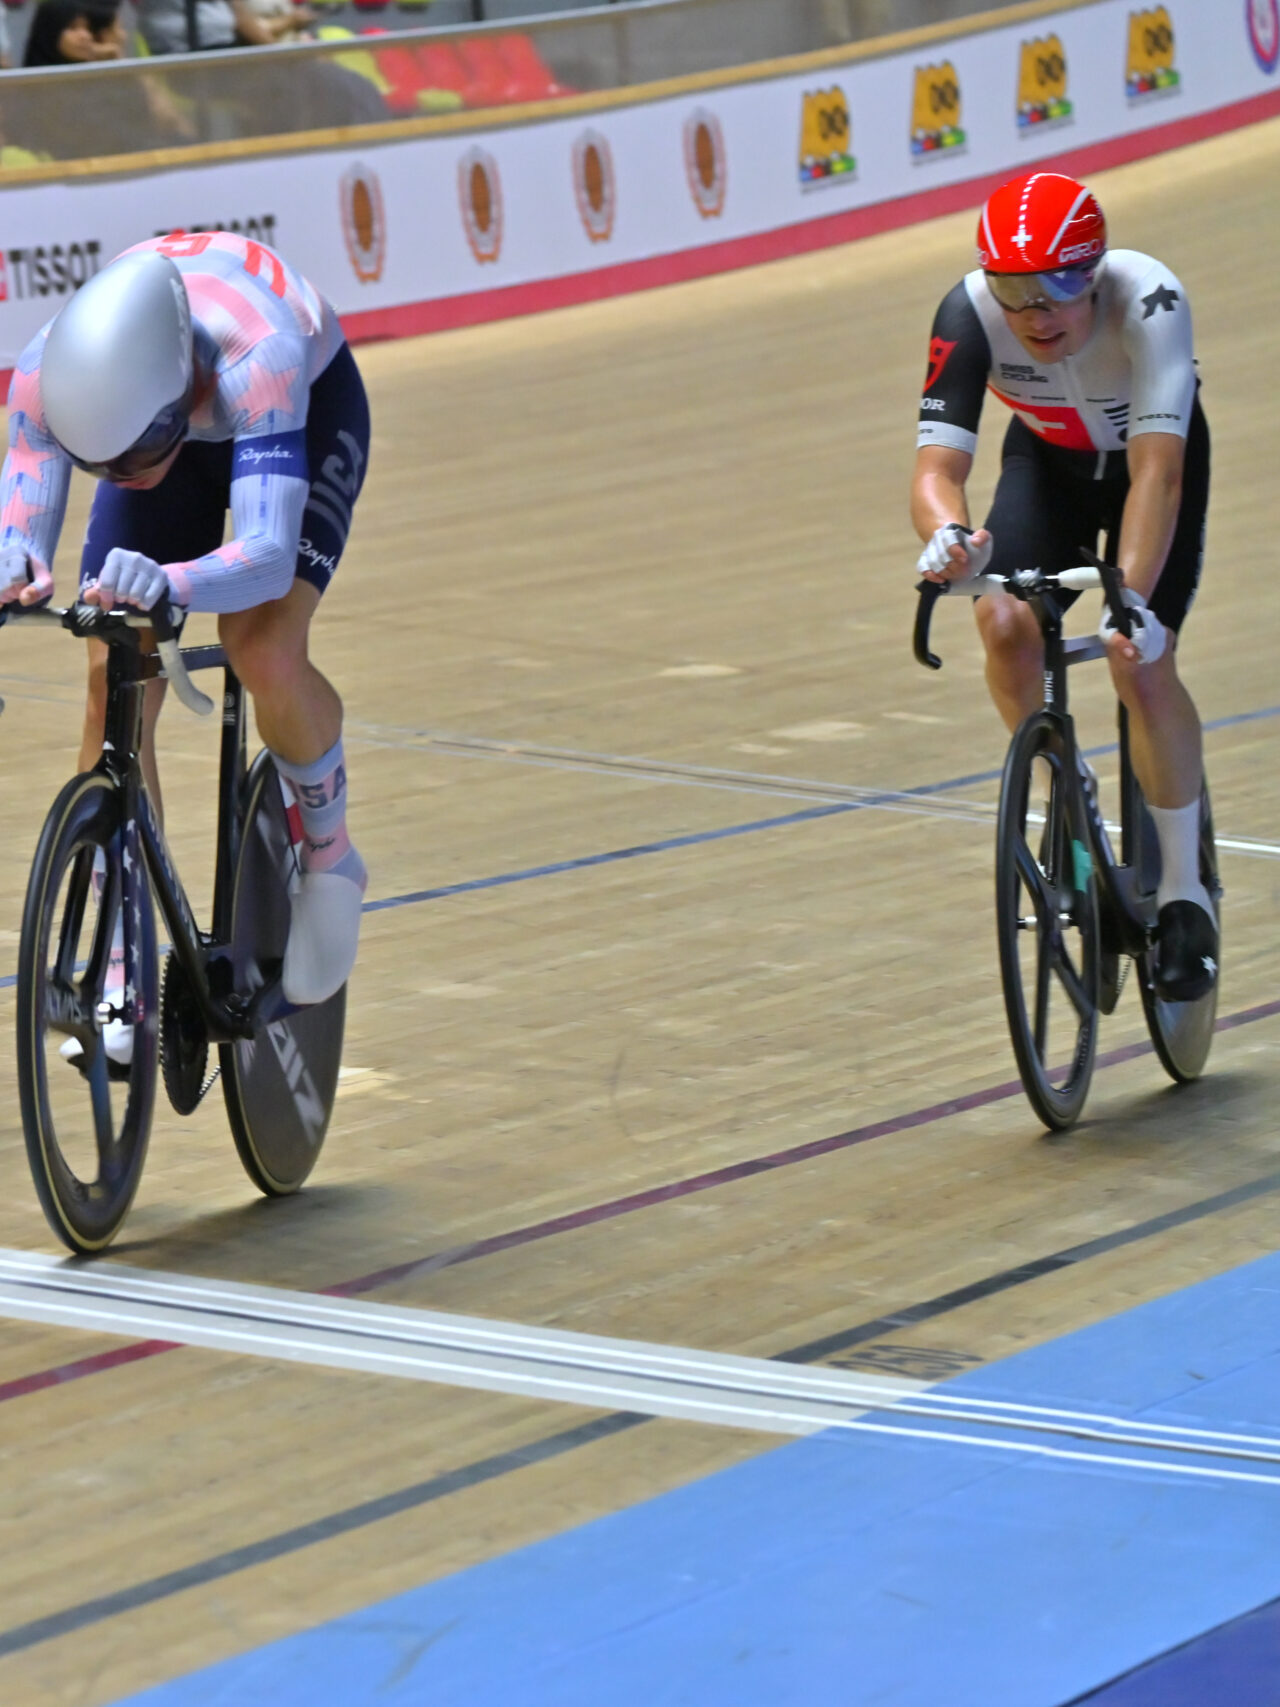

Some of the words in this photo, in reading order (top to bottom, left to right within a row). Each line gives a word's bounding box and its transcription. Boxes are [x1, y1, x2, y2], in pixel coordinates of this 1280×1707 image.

[8, 241, 101, 299] TISSOT
[238, 444, 294, 465] Rapha
[286, 764, 347, 810] SA
